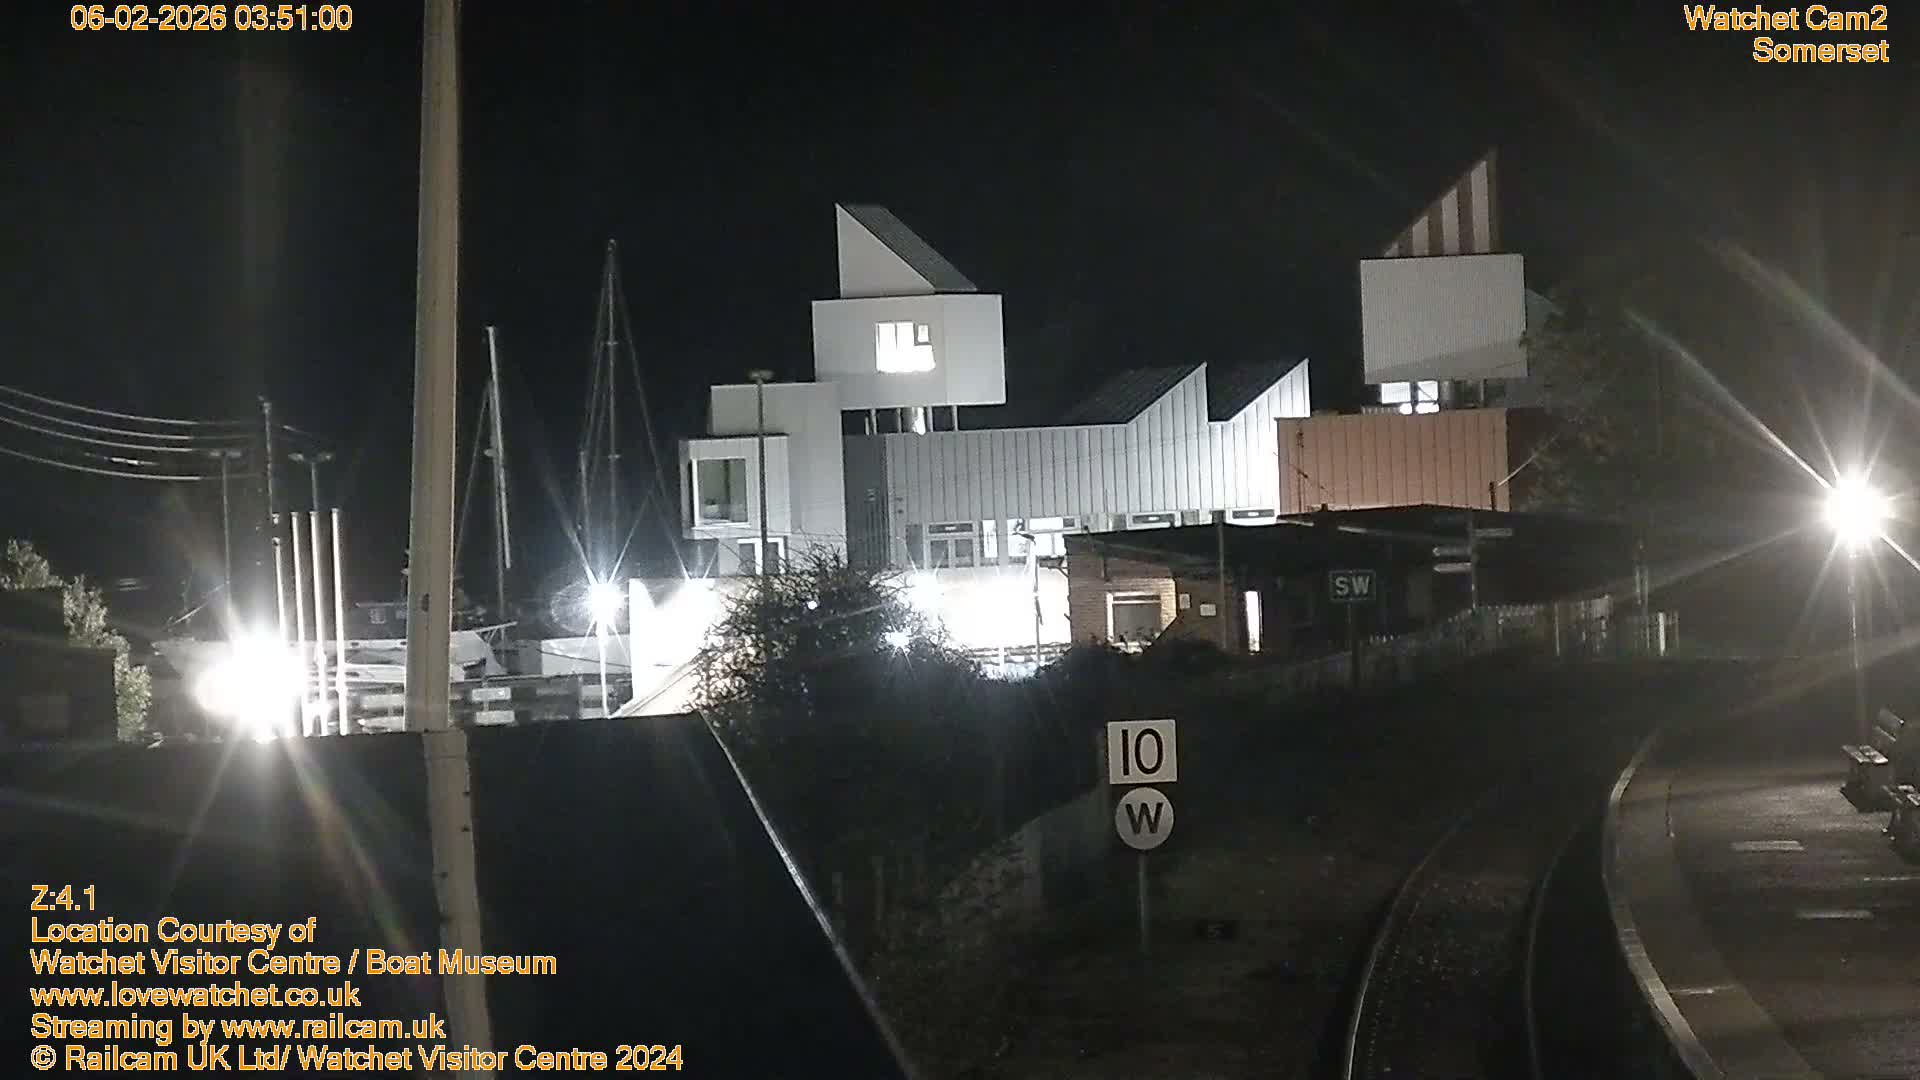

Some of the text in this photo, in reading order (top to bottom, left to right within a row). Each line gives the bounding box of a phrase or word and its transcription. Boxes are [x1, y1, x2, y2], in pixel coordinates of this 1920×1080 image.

[1335, 575, 1370, 595] SW
[1121, 728, 1163, 776] 10
[1125, 802, 1163, 834] W
